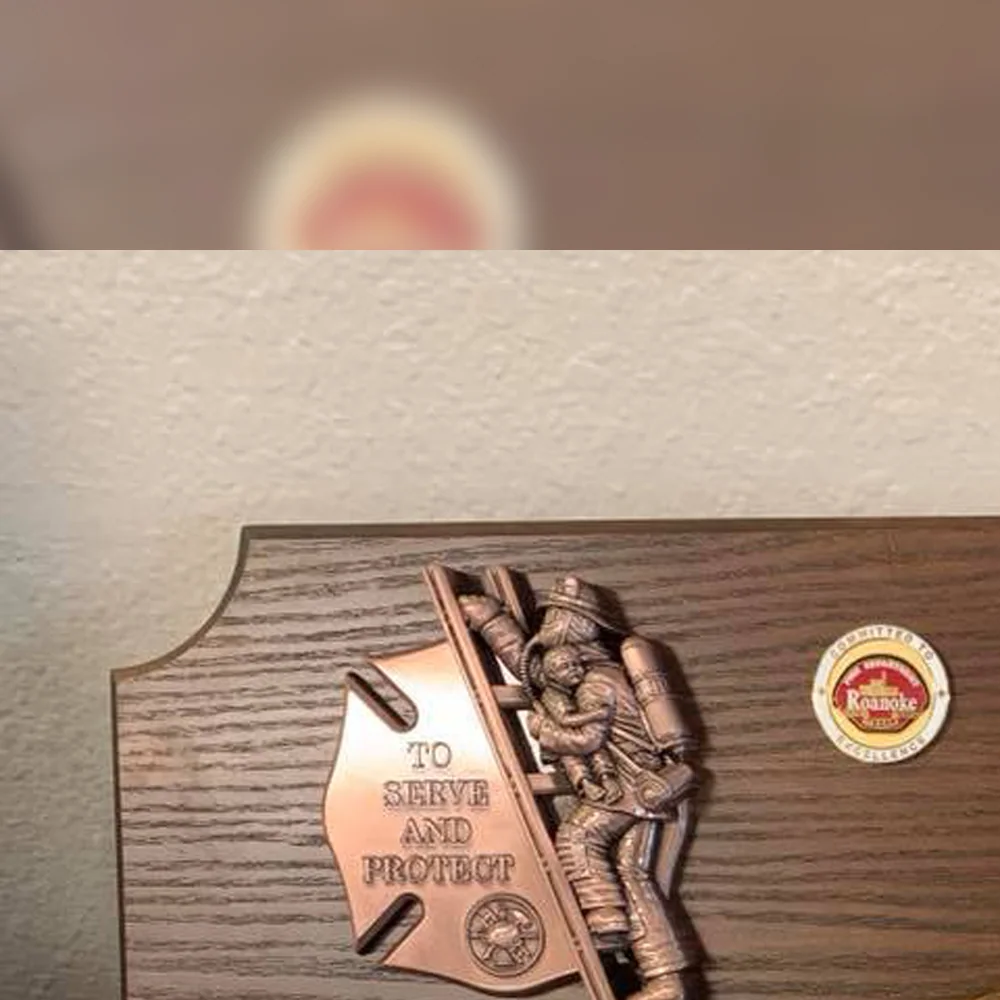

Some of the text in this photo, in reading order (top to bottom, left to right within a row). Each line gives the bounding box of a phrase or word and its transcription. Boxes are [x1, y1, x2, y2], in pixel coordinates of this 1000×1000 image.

[845, 689, 919, 715] Roanoke
[407, 741, 452, 769] TO
[383, 779, 490, 807] SERVE
[401, 816, 474, 845] AND
[362, 853, 516, 884] PROTECT
